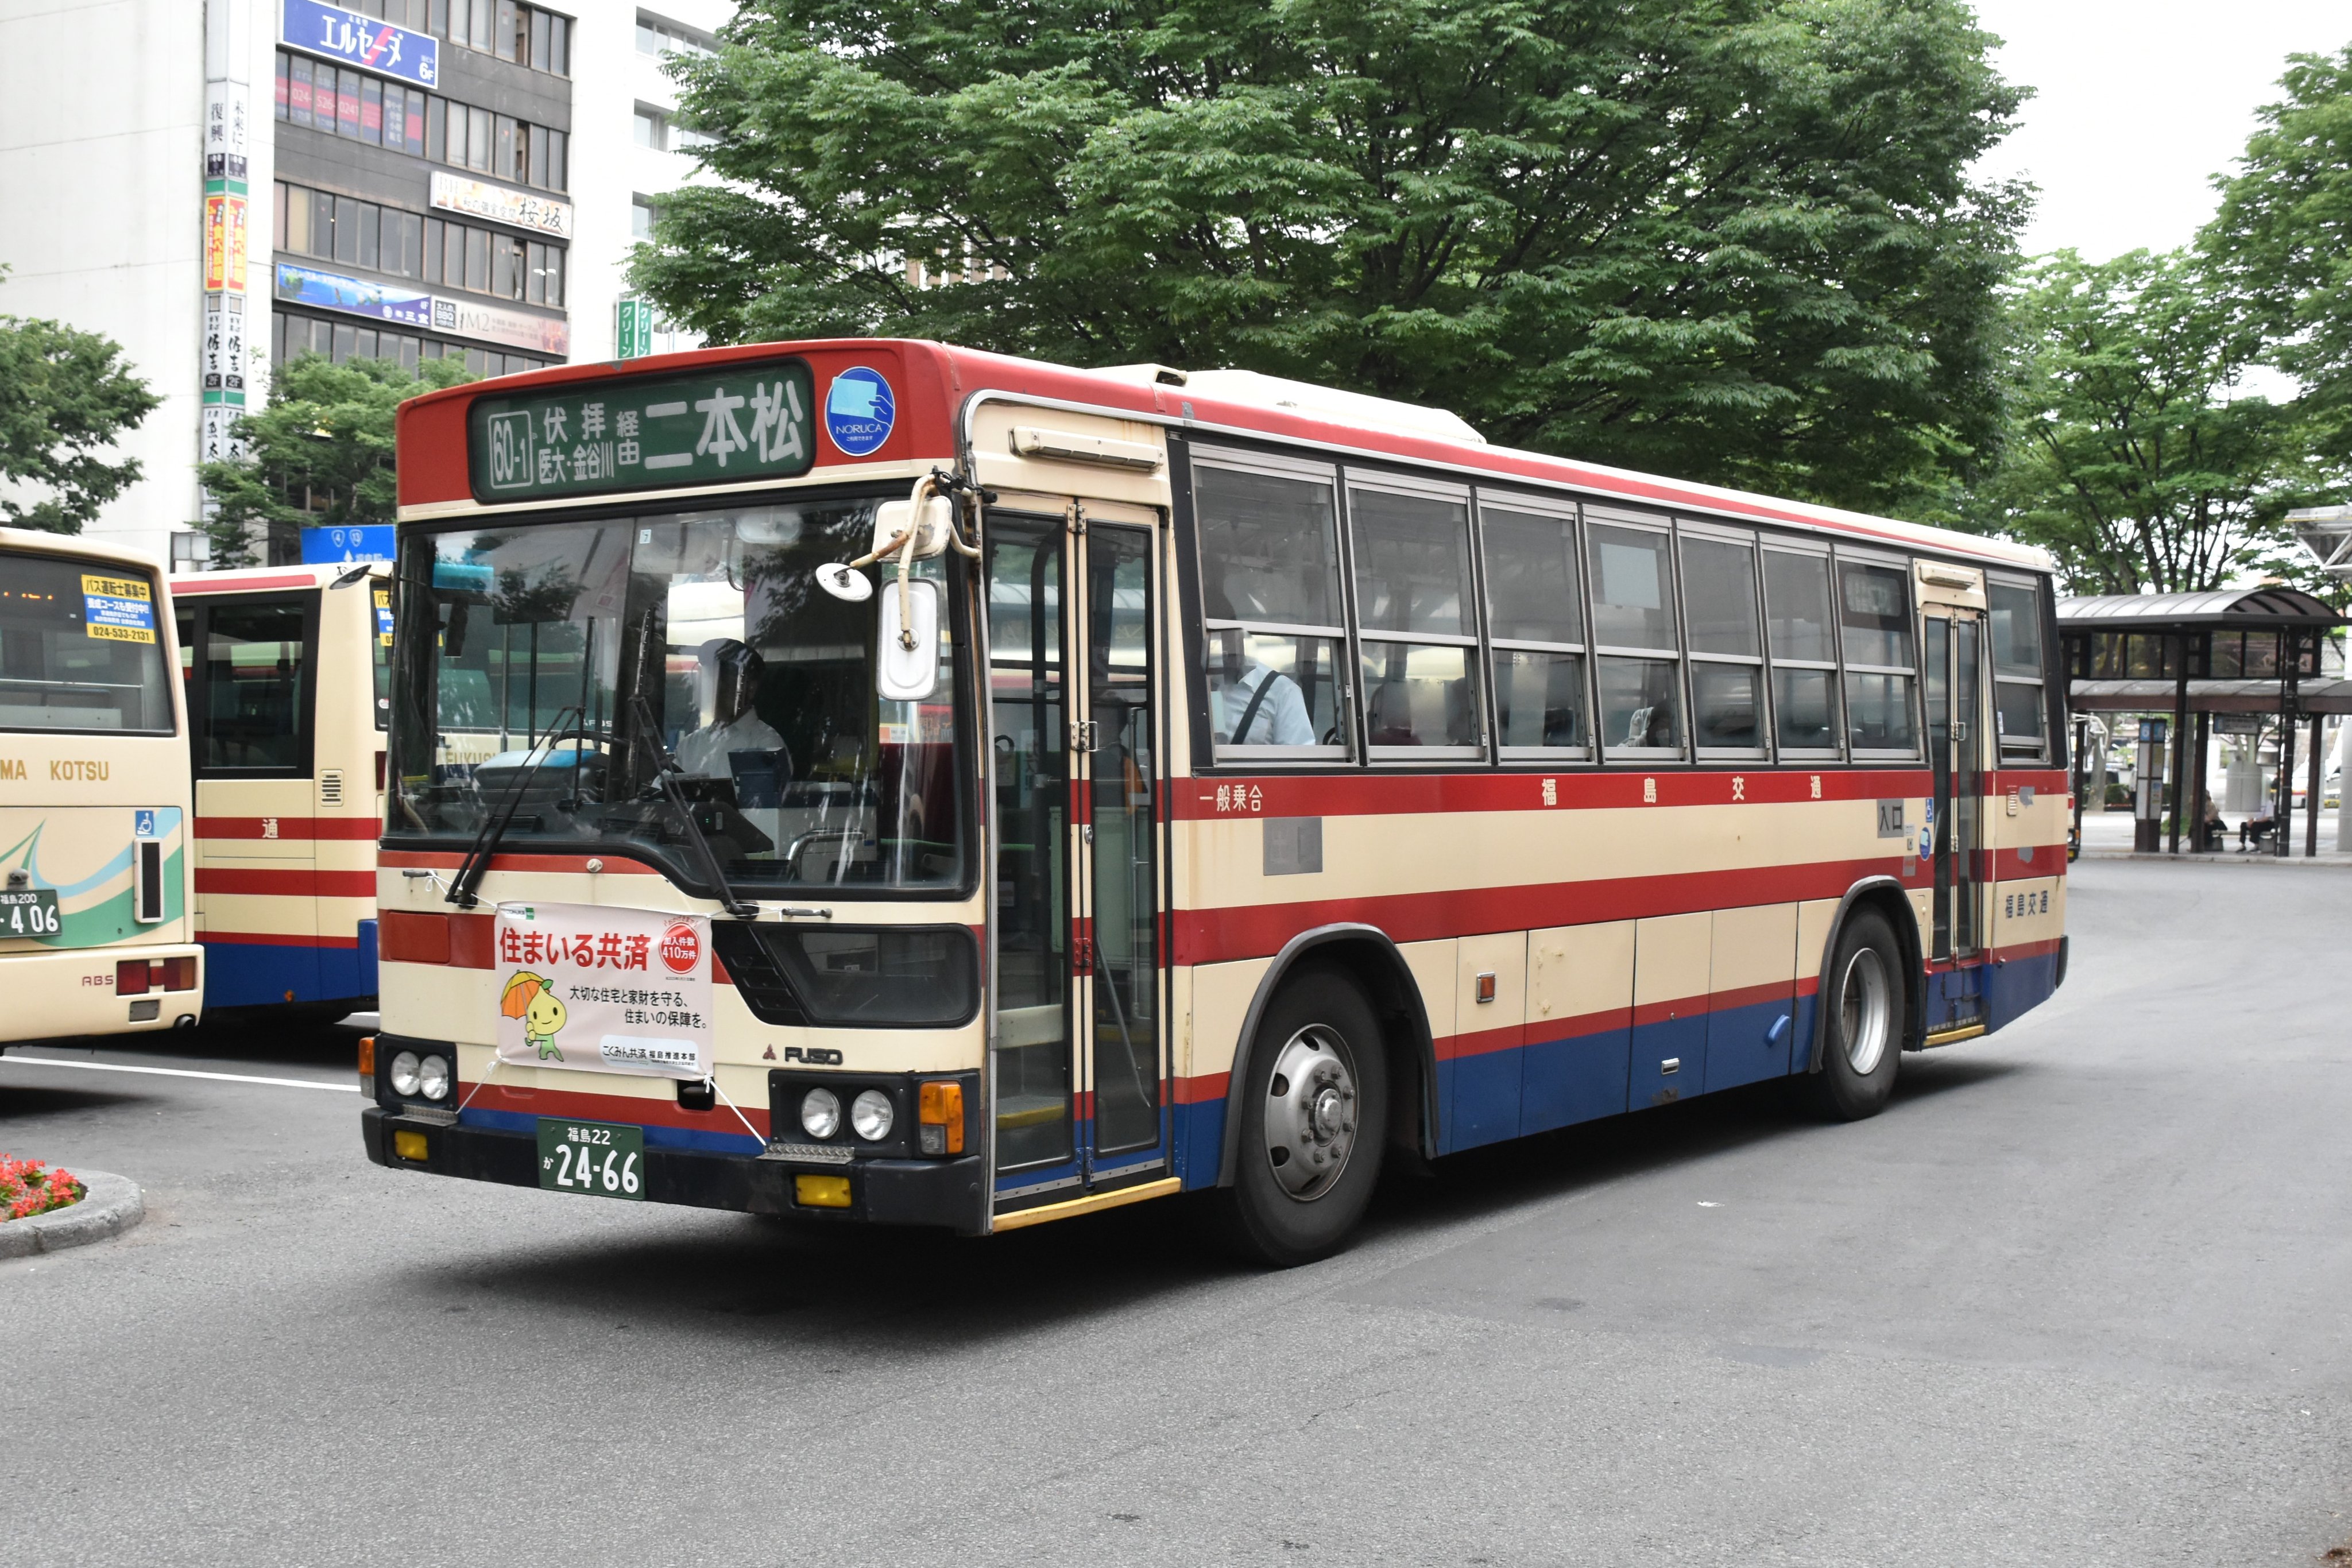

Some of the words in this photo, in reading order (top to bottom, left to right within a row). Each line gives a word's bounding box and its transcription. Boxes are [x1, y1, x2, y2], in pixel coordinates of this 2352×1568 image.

[419, 63, 434, 80] 6F
[519, 198, 564, 232] 桜坂
[544, 403, 606, 444] 伏拝
[644, 380, 803, 470] 二本松
[836, 424, 883, 435] NORUCA
[616, 411, 639, 466] 経由
[493, 420, 527, 482] 60-1
[86, 580, 146, 599] バス運転士募集中
[93, 626, 149, 641] 024-533-2131
[2142, 723, 2150, 737] 6
[50, 760, 109, 781] KOTSU
[1200, 784, 1263, 811] 一般乗合
[1879, 805, 1902, 831] 入口
[262, 819, 278, 838] 通
[2005, 890, 2048, 919] 福島交通
[500, 927, 651, 971] 住まいる共済
[663, 936, 695, 946] 加入件数
[663, 946, 697, 959] 410万件
[82, 975, 114, 986] ABS
[570, 985, 688, 1007] 大切な住宅と家財を守る、
[625, 1009, 706, 1029] 住まいの保障を。
[603, 1046, 647, 1059] こくみん共済
[649, 1050, 696, 1061] 福島推進本部
[785, 1047, 844, 1066] FUSO
[567, 1126, 611, 1145] 福島22
[543, 1156, 554, 1170] か
[555, 1144, 639, 1193] 24-66
